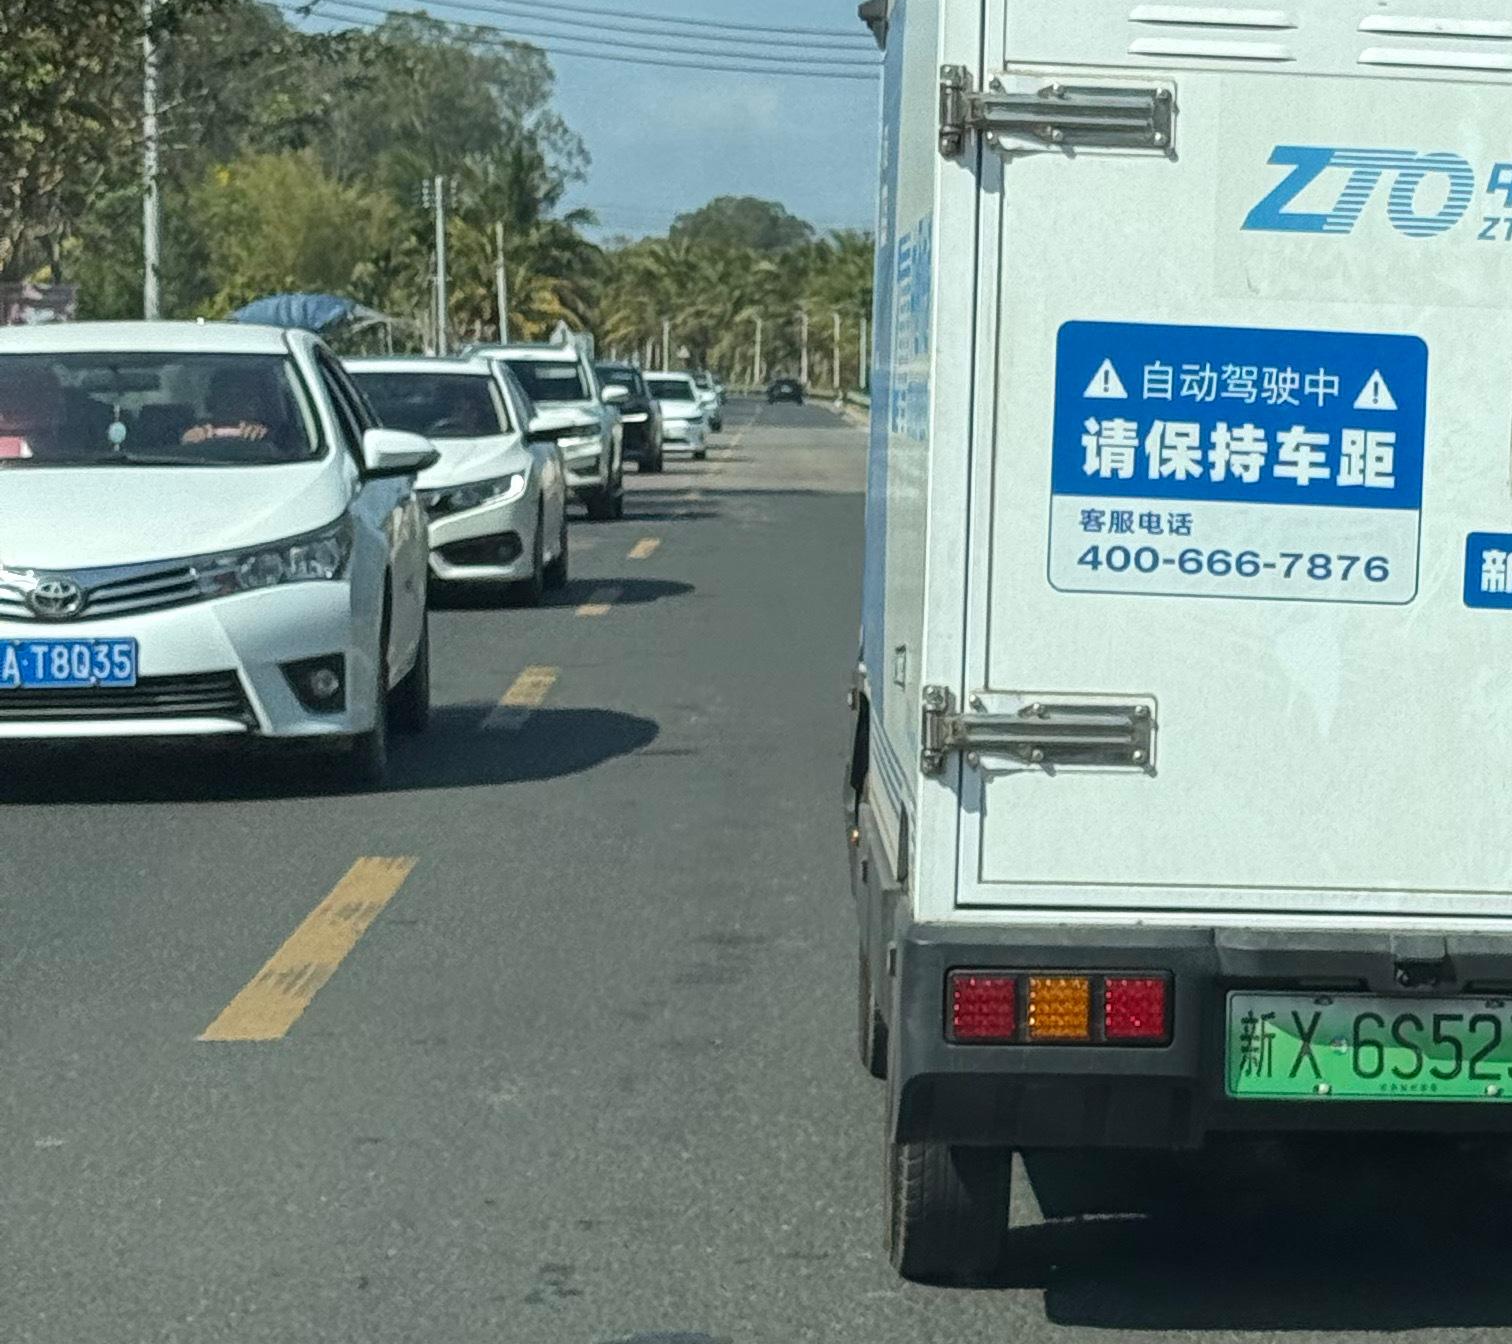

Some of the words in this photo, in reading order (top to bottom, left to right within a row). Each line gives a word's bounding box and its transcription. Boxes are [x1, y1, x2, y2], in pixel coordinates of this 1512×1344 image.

[1240, 145, 1475, 237] ZTO
[1142, 361, 1340, 407] 自动驾驶中
[1081, 417, 1397, 489] 请保持车距
[1078, 508, 1194, 536] 客服电话
[1077, 544, 1390, 583] 400-666-7876
